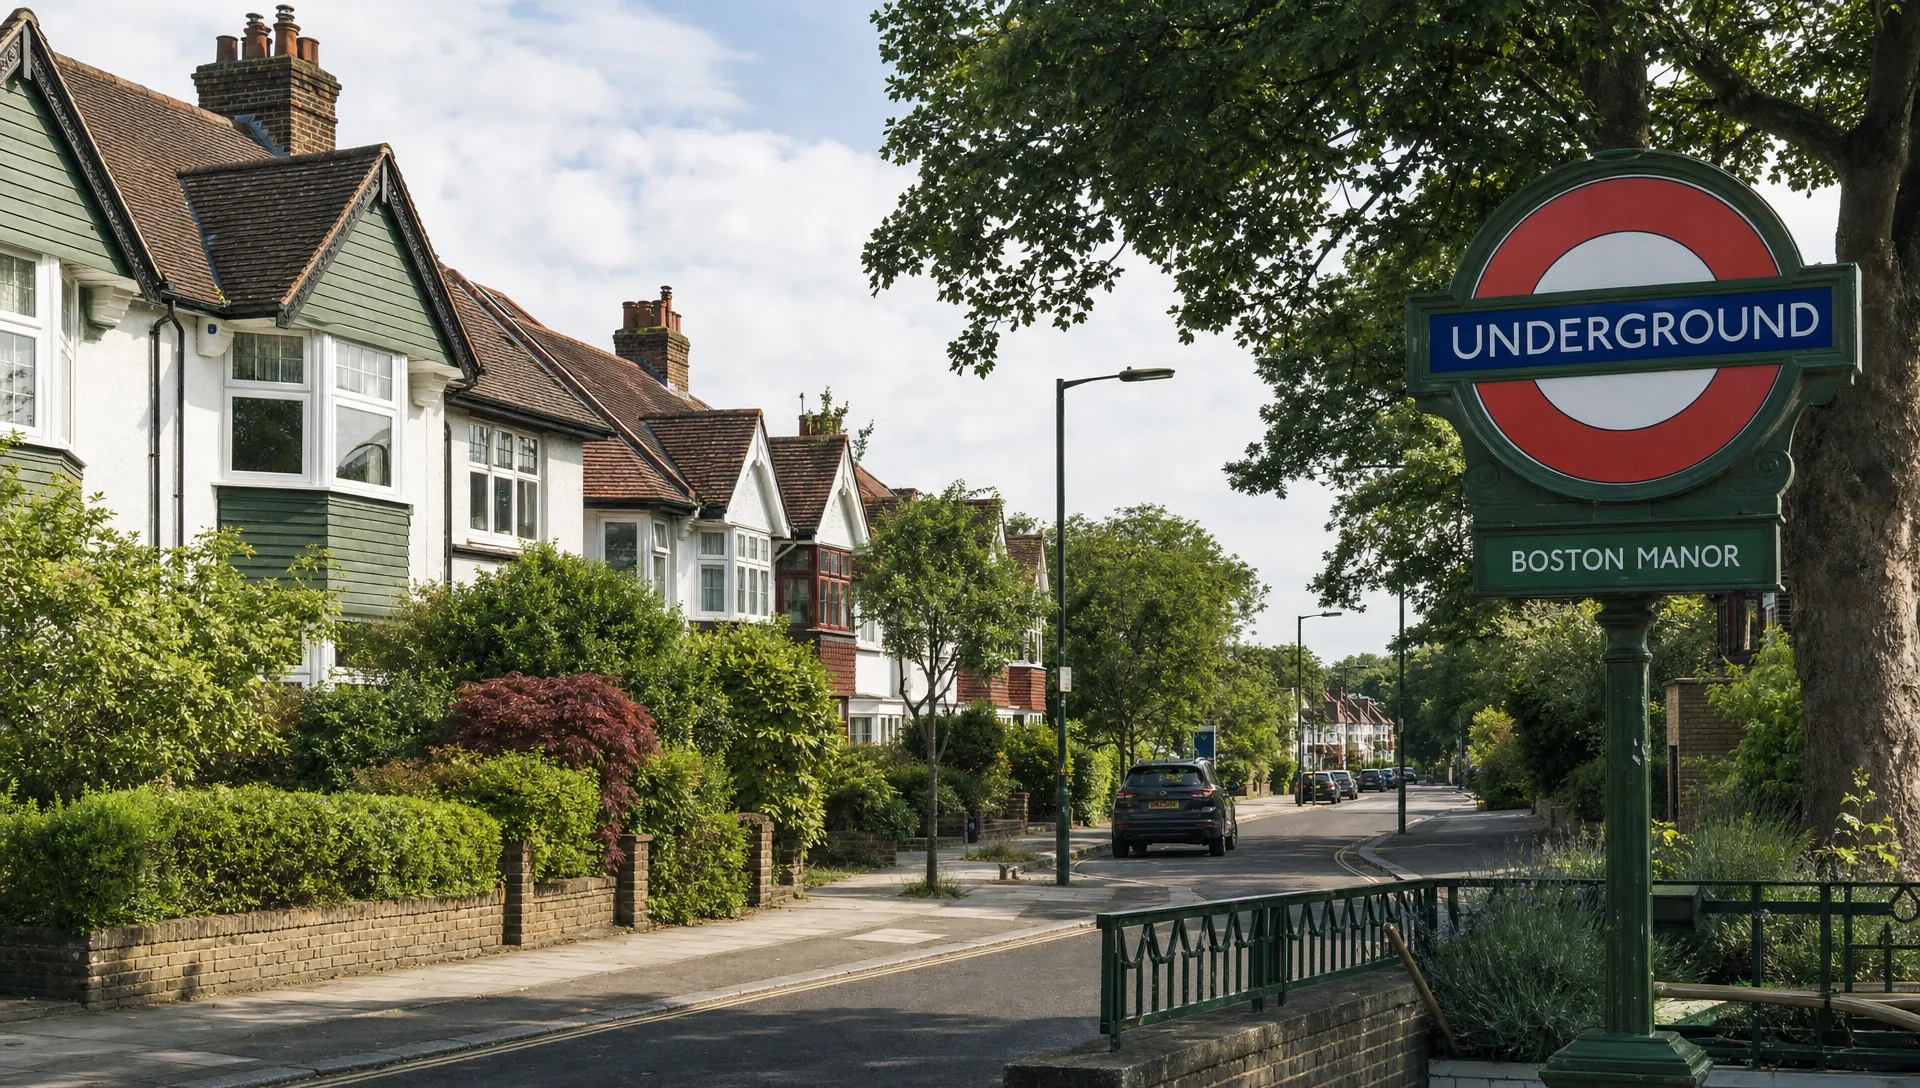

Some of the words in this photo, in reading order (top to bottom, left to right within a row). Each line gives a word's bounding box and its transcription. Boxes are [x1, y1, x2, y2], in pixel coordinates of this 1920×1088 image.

[1452, 302, 1819, 360] UNDERGROUND
[1511, 547, 1624, 573] BOSTON
[1637, 544, 1741, 570] MANOR
